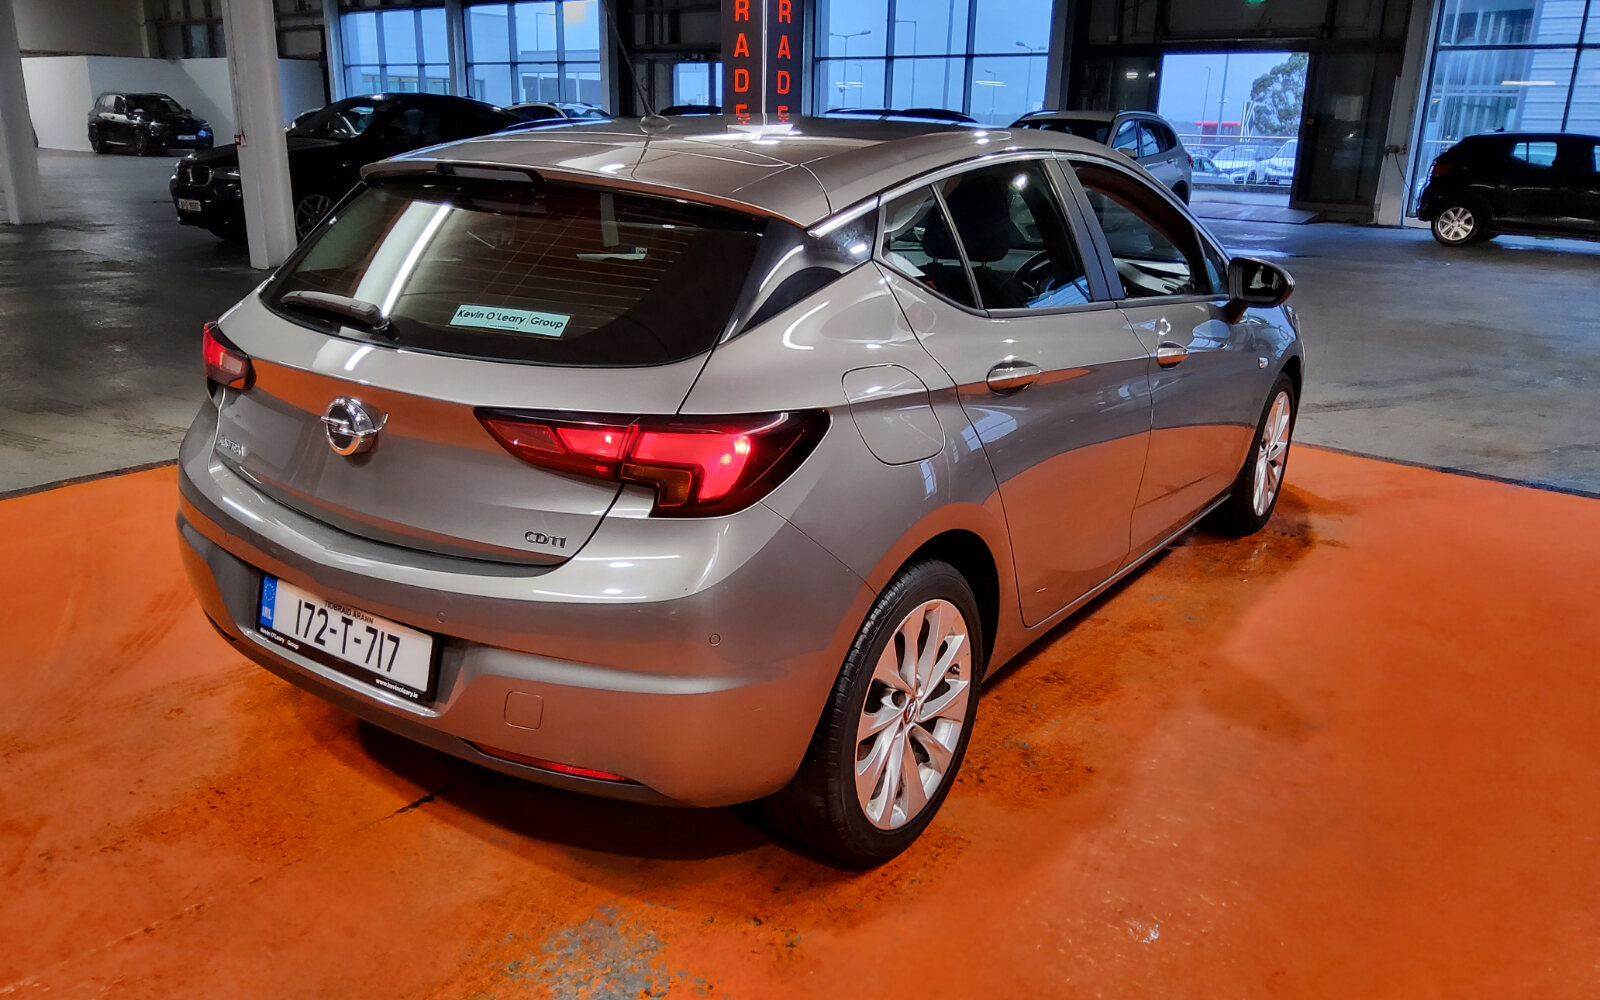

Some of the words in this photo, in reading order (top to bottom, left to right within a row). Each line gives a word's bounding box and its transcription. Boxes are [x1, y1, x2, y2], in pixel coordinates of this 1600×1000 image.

[457, 309, 484, 319] Kevin
[486, 311, 526, 324] O'Leary
[530, 316, 564, 329] Group
[261, 606, 273, 620] IRL
[325, 600, 352, 616] TIOBRAID
[295, 599, 401, 673] 172-T-717
